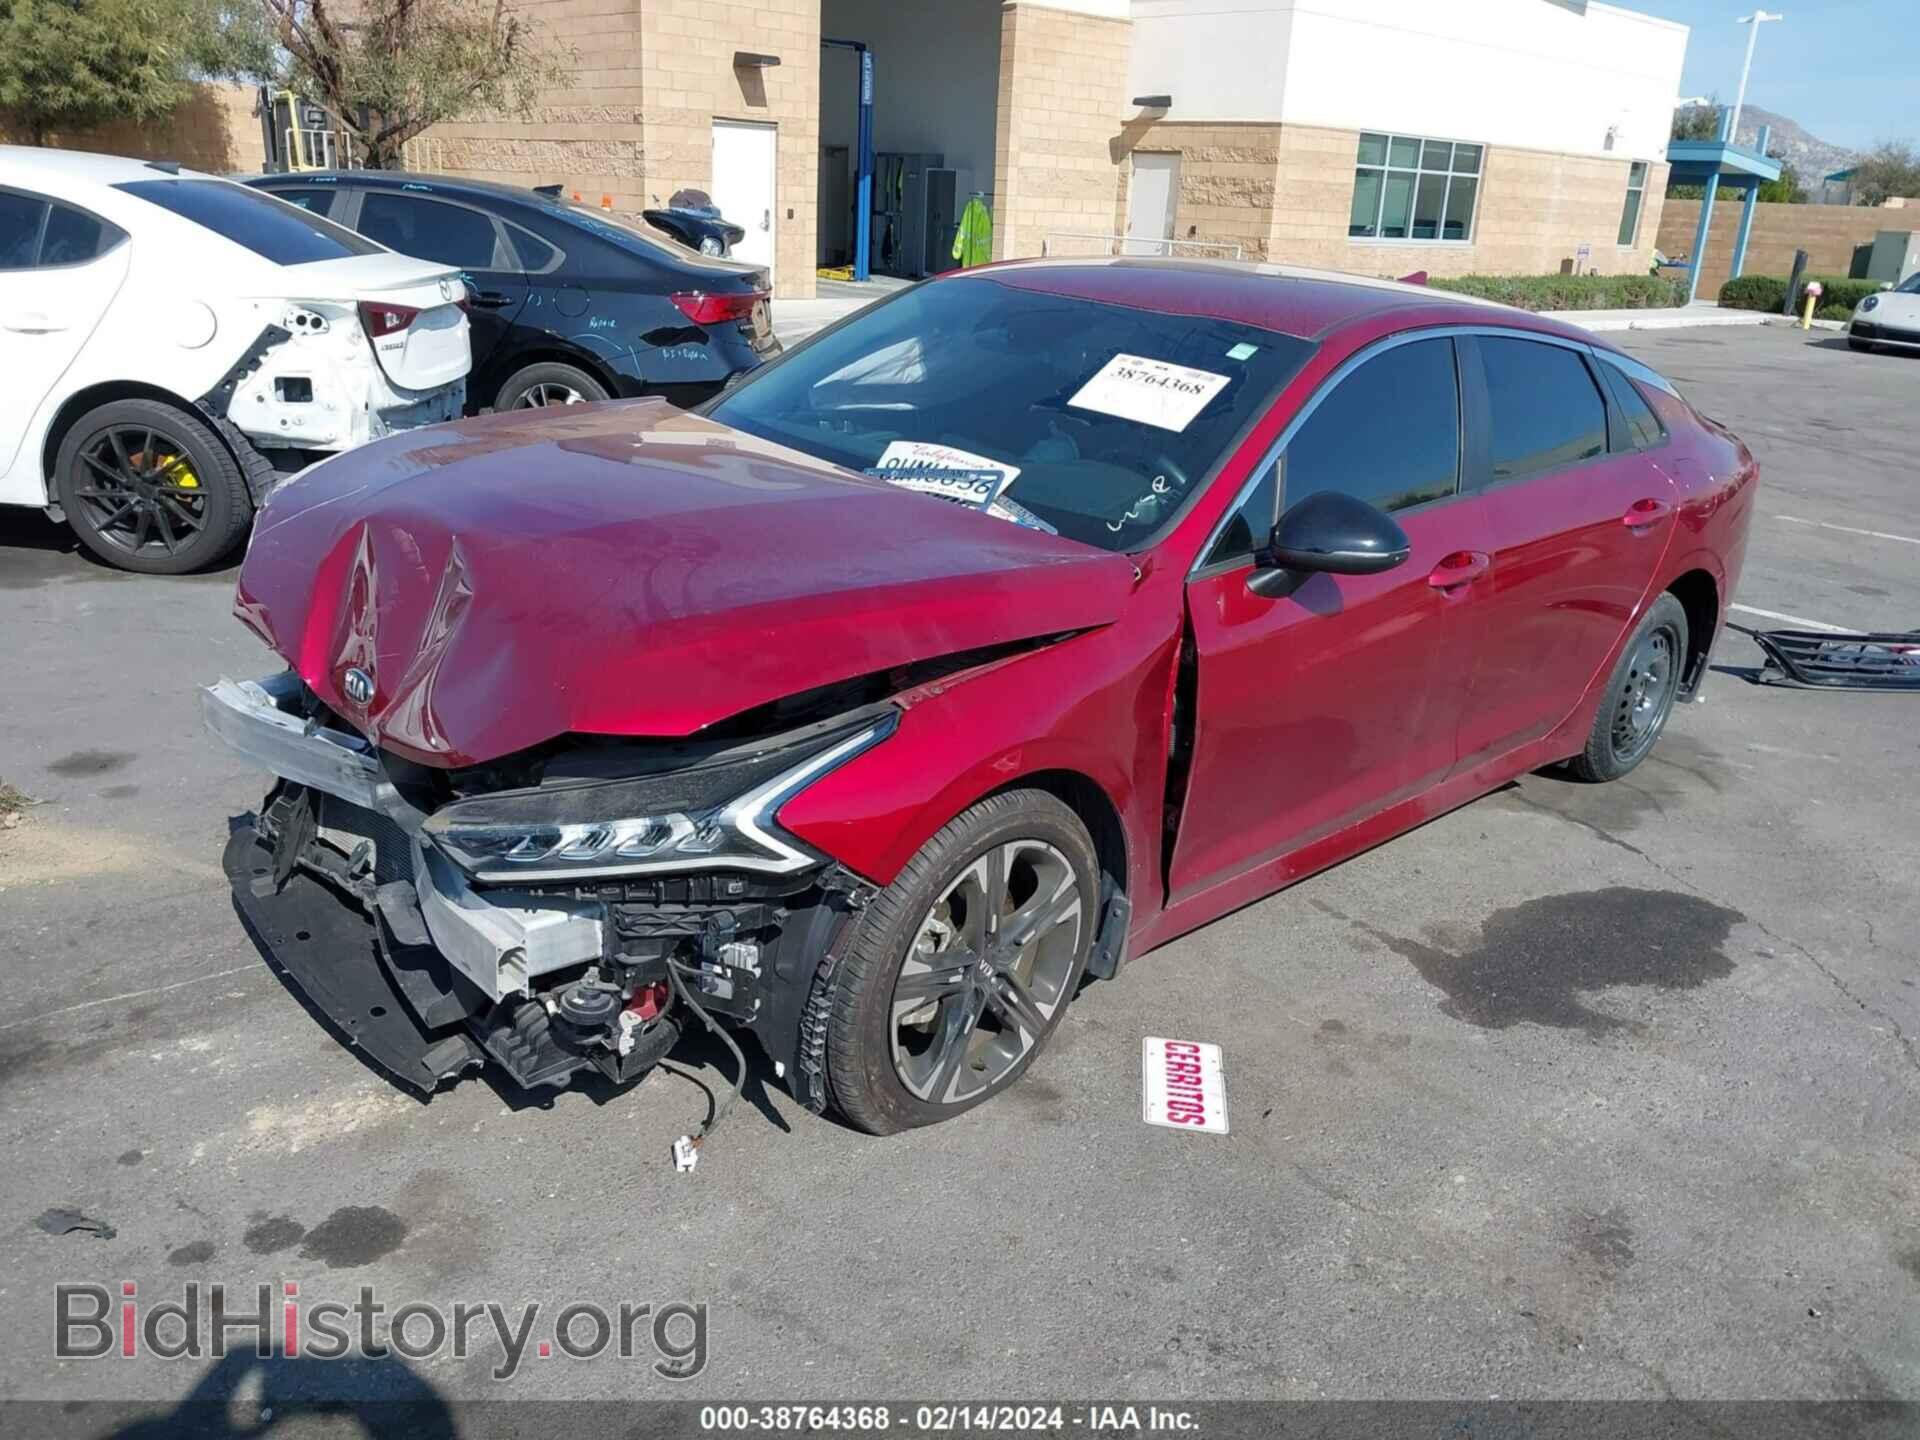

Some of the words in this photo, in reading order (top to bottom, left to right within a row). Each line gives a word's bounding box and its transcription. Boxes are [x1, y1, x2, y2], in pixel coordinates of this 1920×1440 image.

[1110, 366, 1206, 396] 38764368
[345, 672, 366, 702] KIA
[1165, 1041, 1206, 1126] CERRITOS
